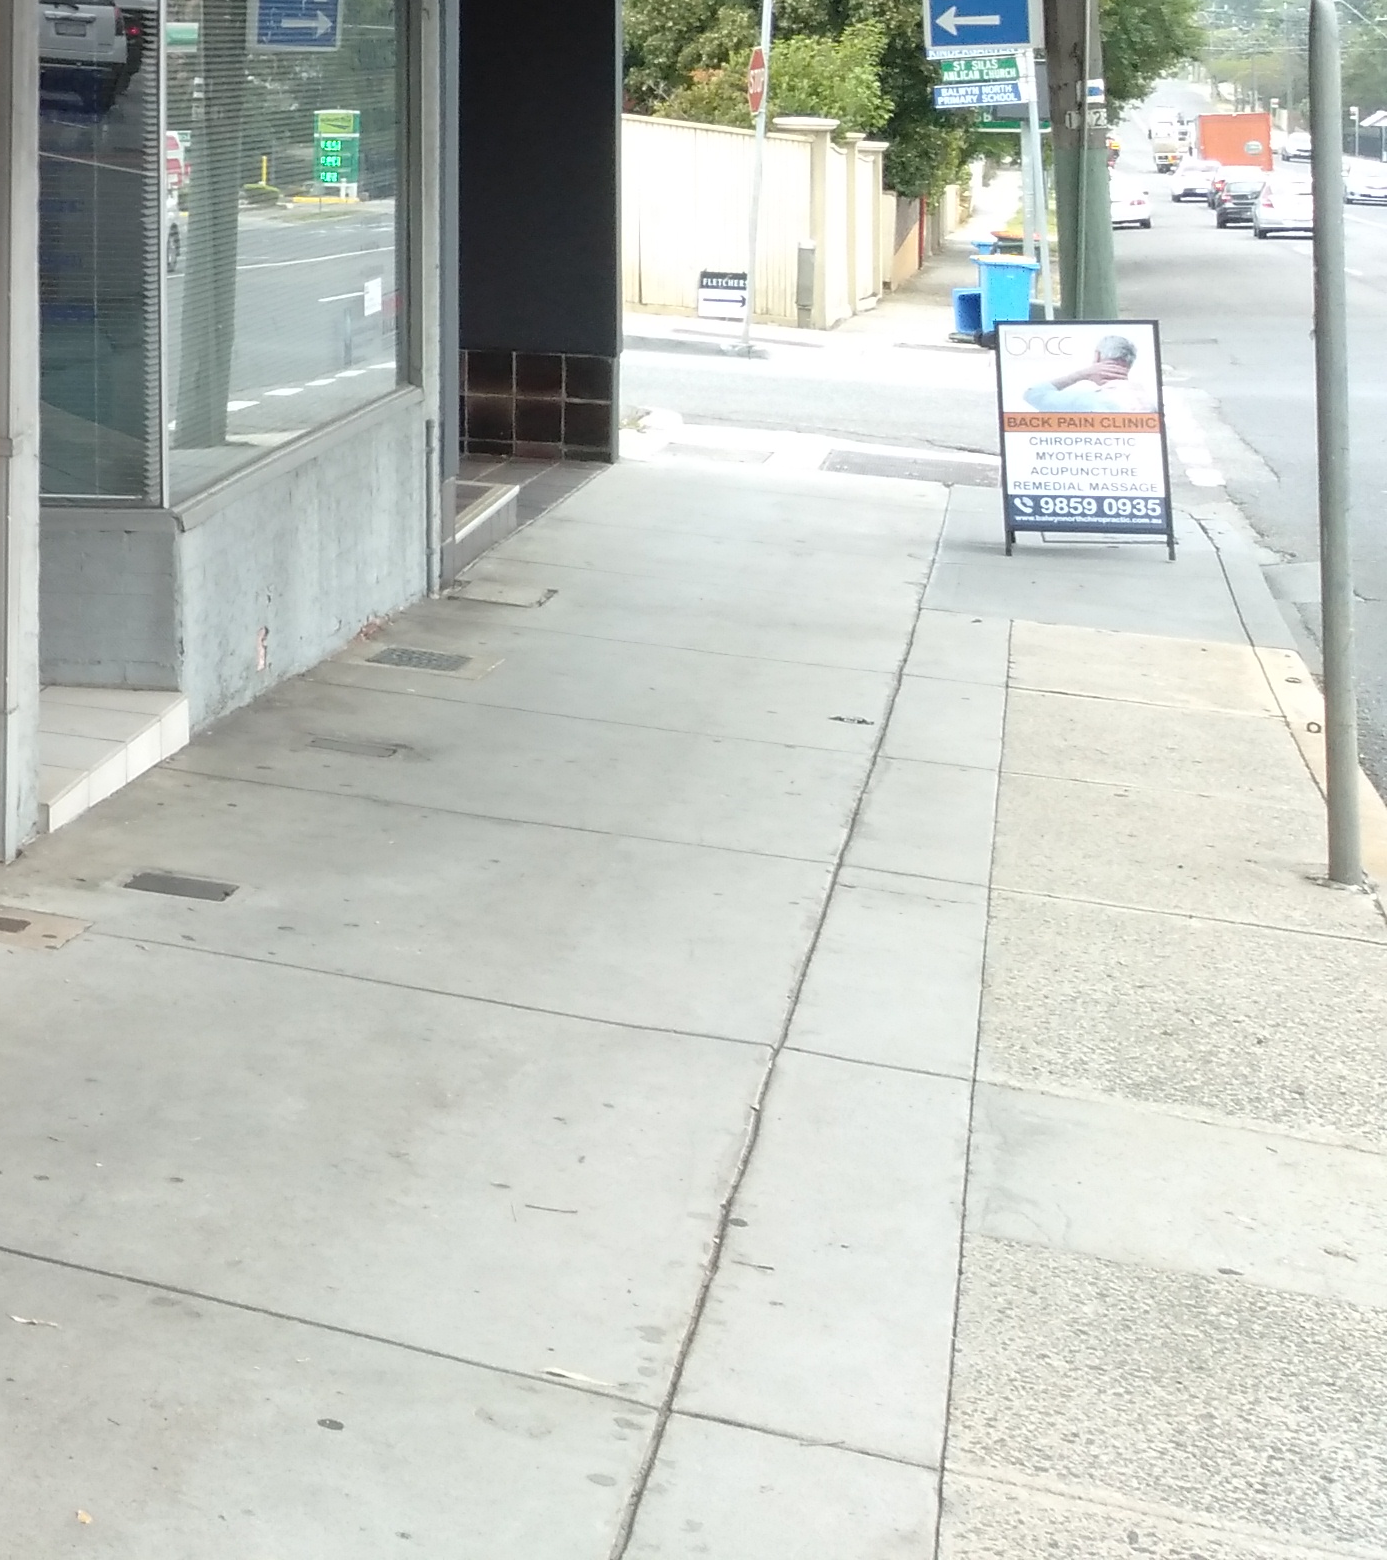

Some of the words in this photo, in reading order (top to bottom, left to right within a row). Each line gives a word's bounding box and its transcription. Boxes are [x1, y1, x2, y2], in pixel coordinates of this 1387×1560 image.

[953, 60, 966, 71] ST
[972, 60, 998, 71] SILAS
[983, 68, 1017, 80] CHURCH
[941, 86, 980, 97] BALWYN
[982, 84, 1013, 94] NORTH
[937, 95, 978, 105] PRIMARY
[982, 93, 1018, 103] SCHOOL
[1007, 416, 1052, 428] BACK
[1057, 417, 1095, 428] PAIN
[1100, 417, 1158, 429] CLINIC
[1029, 436, 1137, 447] CHIROPRACTIC
[1036, 451, 1132, 462] MYOTHERAPY
[1030, 466, 1138, 477] ACUPUNCTURE
[1013, 481, 1083, 491] REMEDIAL
[1089, 482, 1158, 493] MASSAGE
[1039, 497, 1097, 515] 9859
[1103, 498, 1162, 516] 0935
